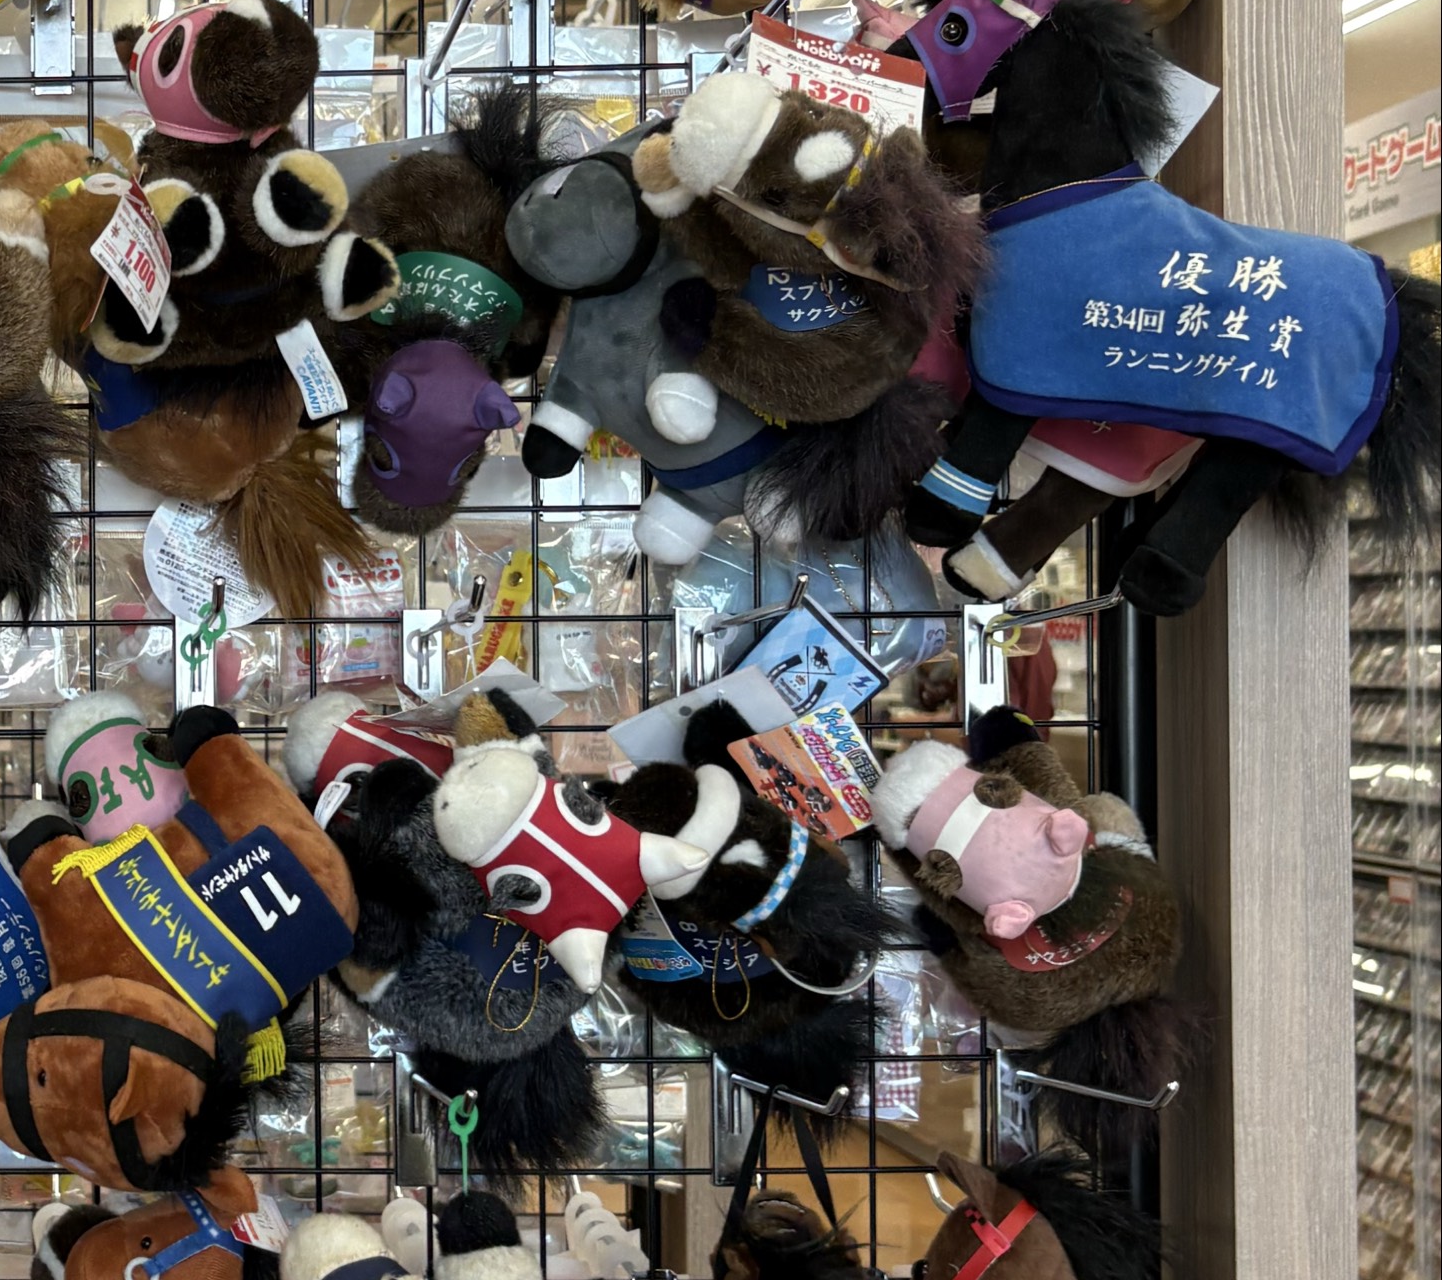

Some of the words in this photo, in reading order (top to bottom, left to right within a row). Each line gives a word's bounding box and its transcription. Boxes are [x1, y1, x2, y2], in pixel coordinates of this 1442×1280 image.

[123, 240, 157, 294] 1,100
[1158, 250, 1288, 303] 優勝
[1081, 298, 1166, 336] 第34回
[1175, 303, 1303, 360] 弥生賞
[1102, 343, 1279, 391] ランニングゲイル
[201, 844, 272, 902] サトノダイヤモンド
[238, 869, 302, 932] 11
[114, 856, 231, 989] サトノダイヤモンド号
